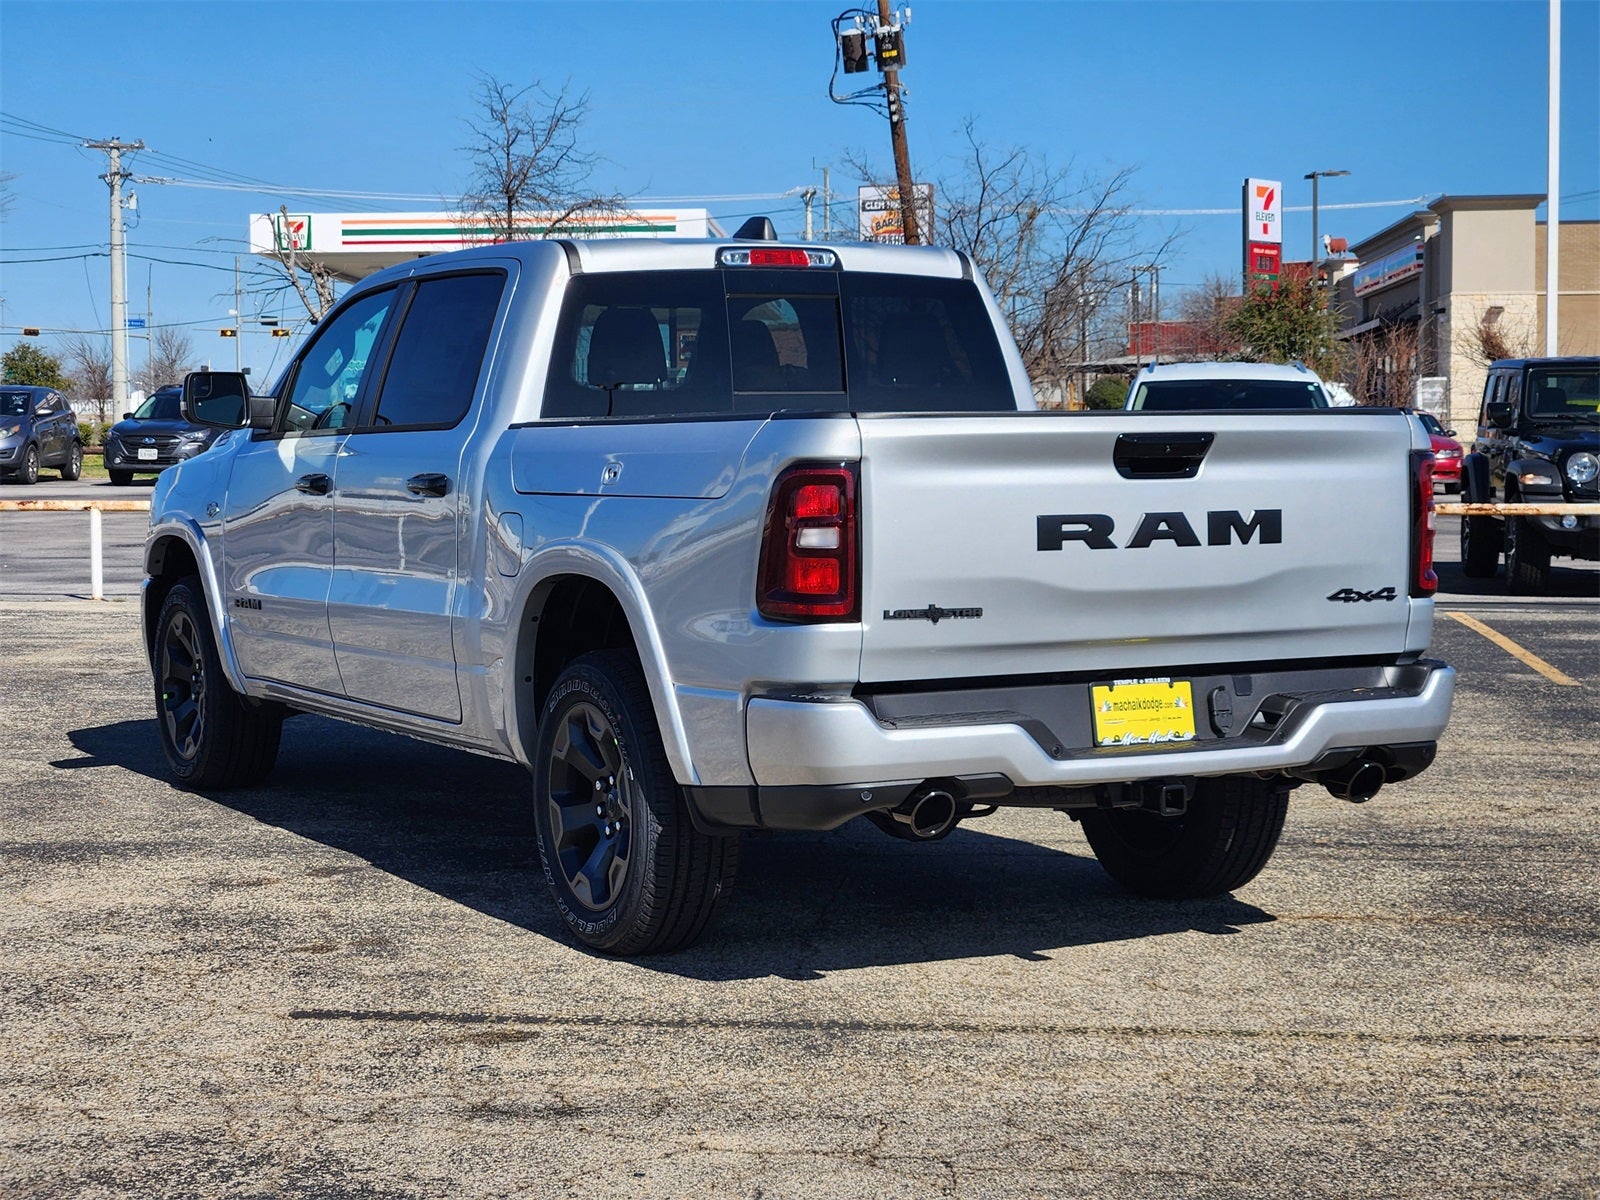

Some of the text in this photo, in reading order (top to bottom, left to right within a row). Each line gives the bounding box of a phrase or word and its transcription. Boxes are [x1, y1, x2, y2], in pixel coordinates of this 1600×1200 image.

[1037, 509, 1282, 551] RAM
[234, 598, 262, 610] RAM
[883, 607, 983, 620] LONE STAR
[558, 897, 618, 933] DUELER
